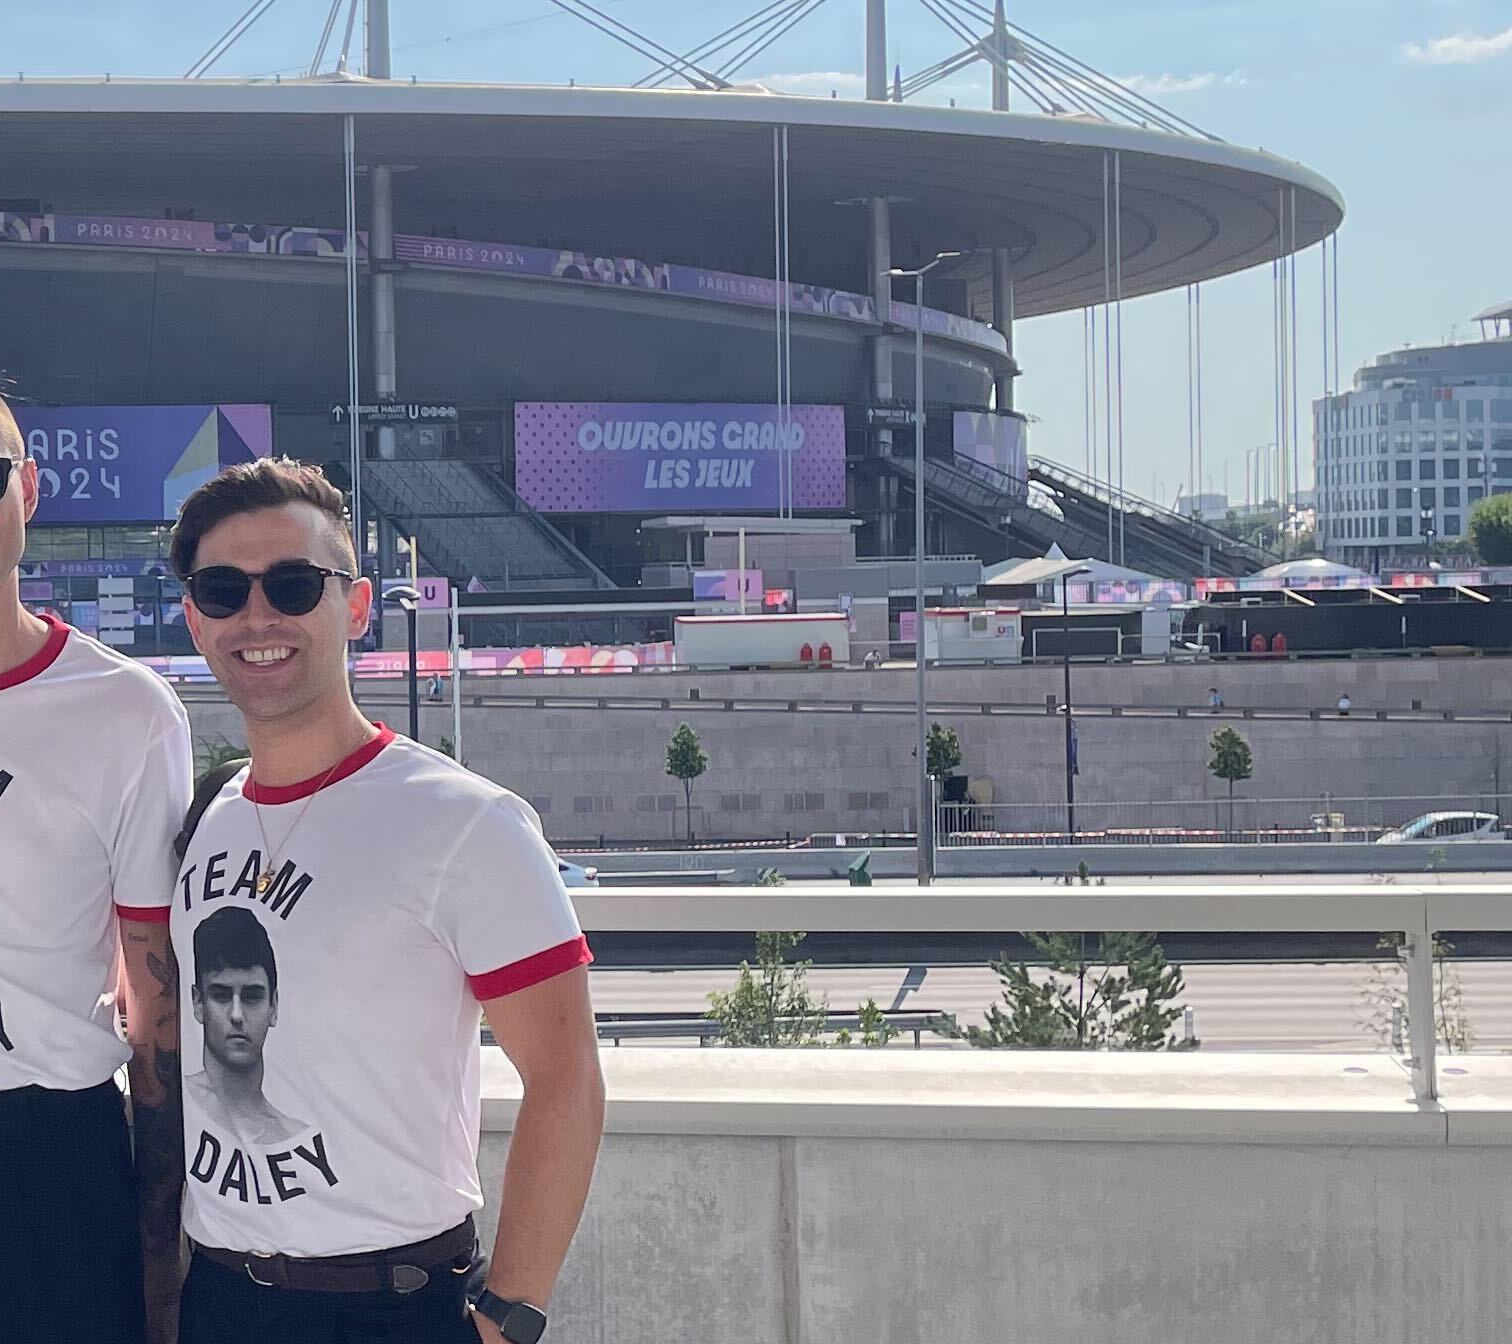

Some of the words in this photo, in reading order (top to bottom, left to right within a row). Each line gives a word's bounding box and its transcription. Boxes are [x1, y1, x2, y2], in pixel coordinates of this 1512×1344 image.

[77, 223, 134, 238] PARIS
[424, 244, 473, 261] PARIS
[408, 404, 419, 419] U
[28, 428, 119, 460] ARIS
[578, 420, 717, 451] OUVRONS
[722, 421, 805, 450] GRAND
[37, 467, 120, 499] 024
[644, 458, 692, 489] LES
[695, 458, 756, 488] JEUX
[424, 586, 436, 600] U
[181, 849, 313, 921] TEAM
[189, 1130, 339, 1205] DALEY
